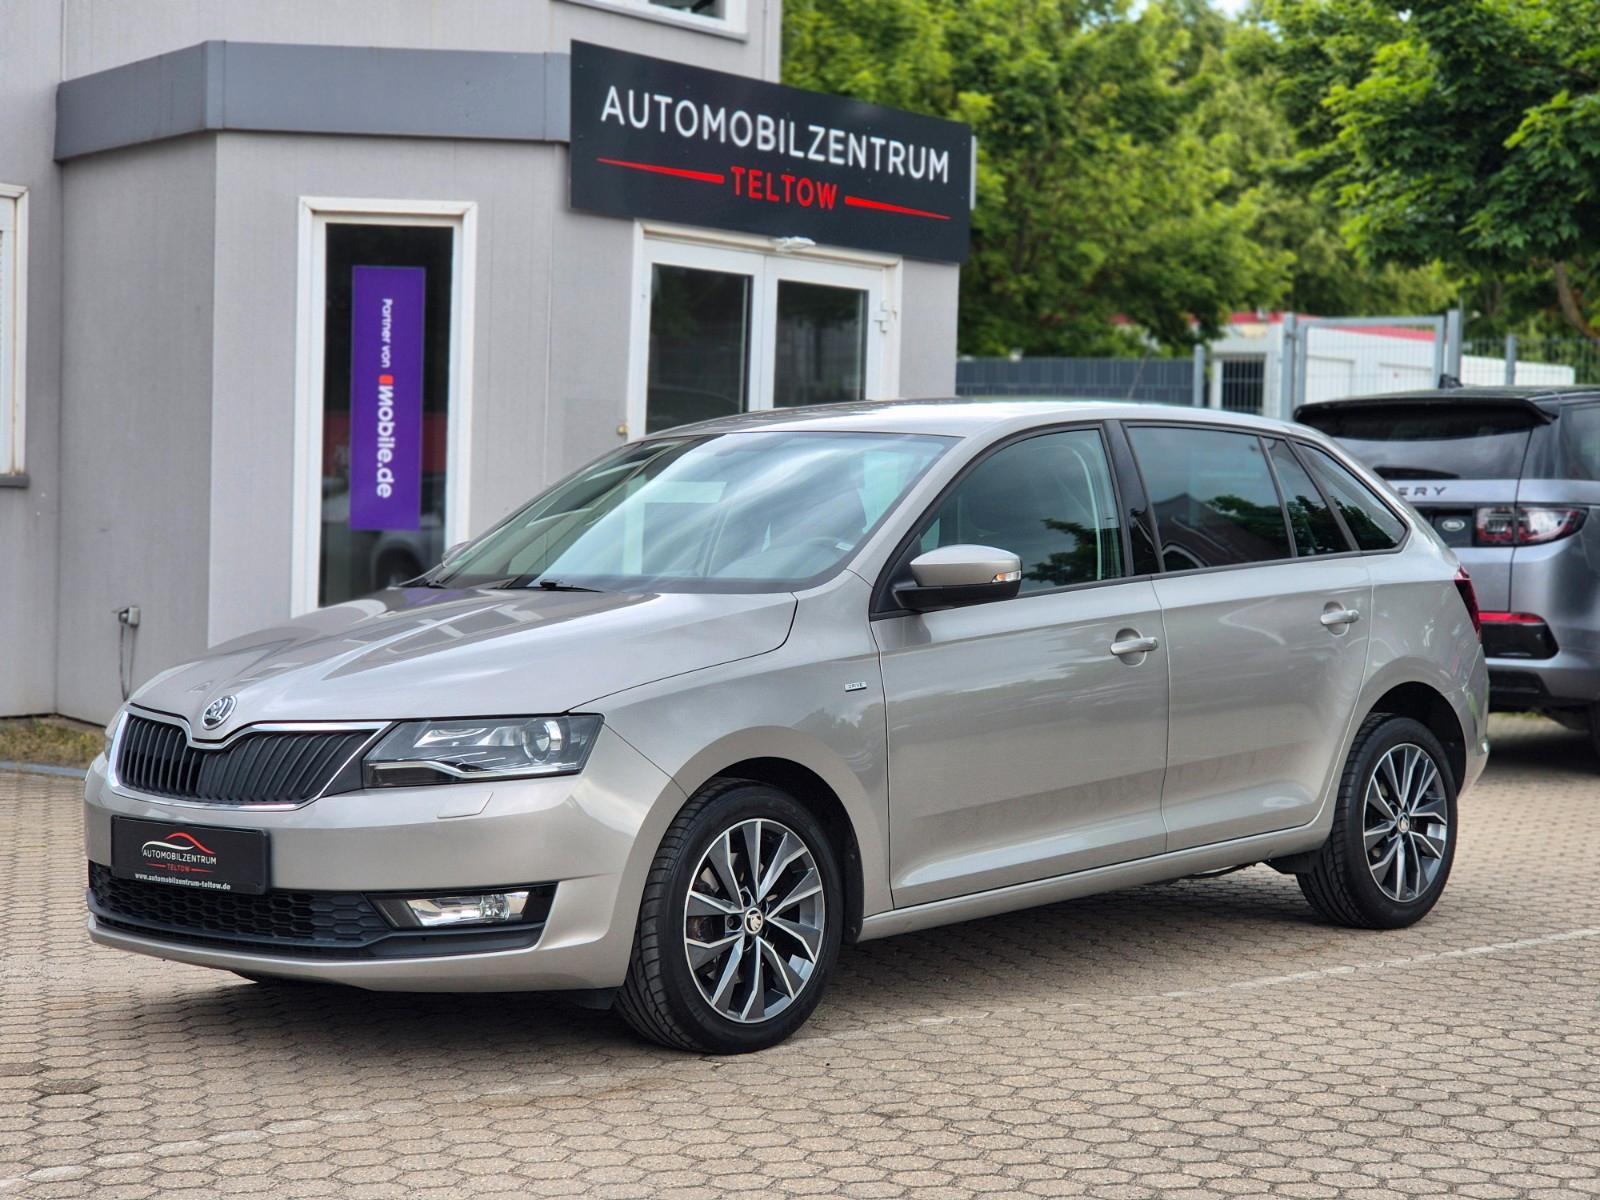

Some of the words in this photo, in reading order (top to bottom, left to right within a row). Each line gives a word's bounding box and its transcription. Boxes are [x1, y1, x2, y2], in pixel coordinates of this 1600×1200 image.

[600, 84, 949, 184] AUTOMOBILZENTRUM
[731, 166, 838, 210] TELTOW
[381, 298, 393, 343] Partner
[381, 345, 391, 368] von
[142, 850, 217, 865] AUTOMOBILZENTRUM
[167, 863, 191, 872] TELTOW
[134, 872, 231, 890] www.automobilzentrum-teltow.de
